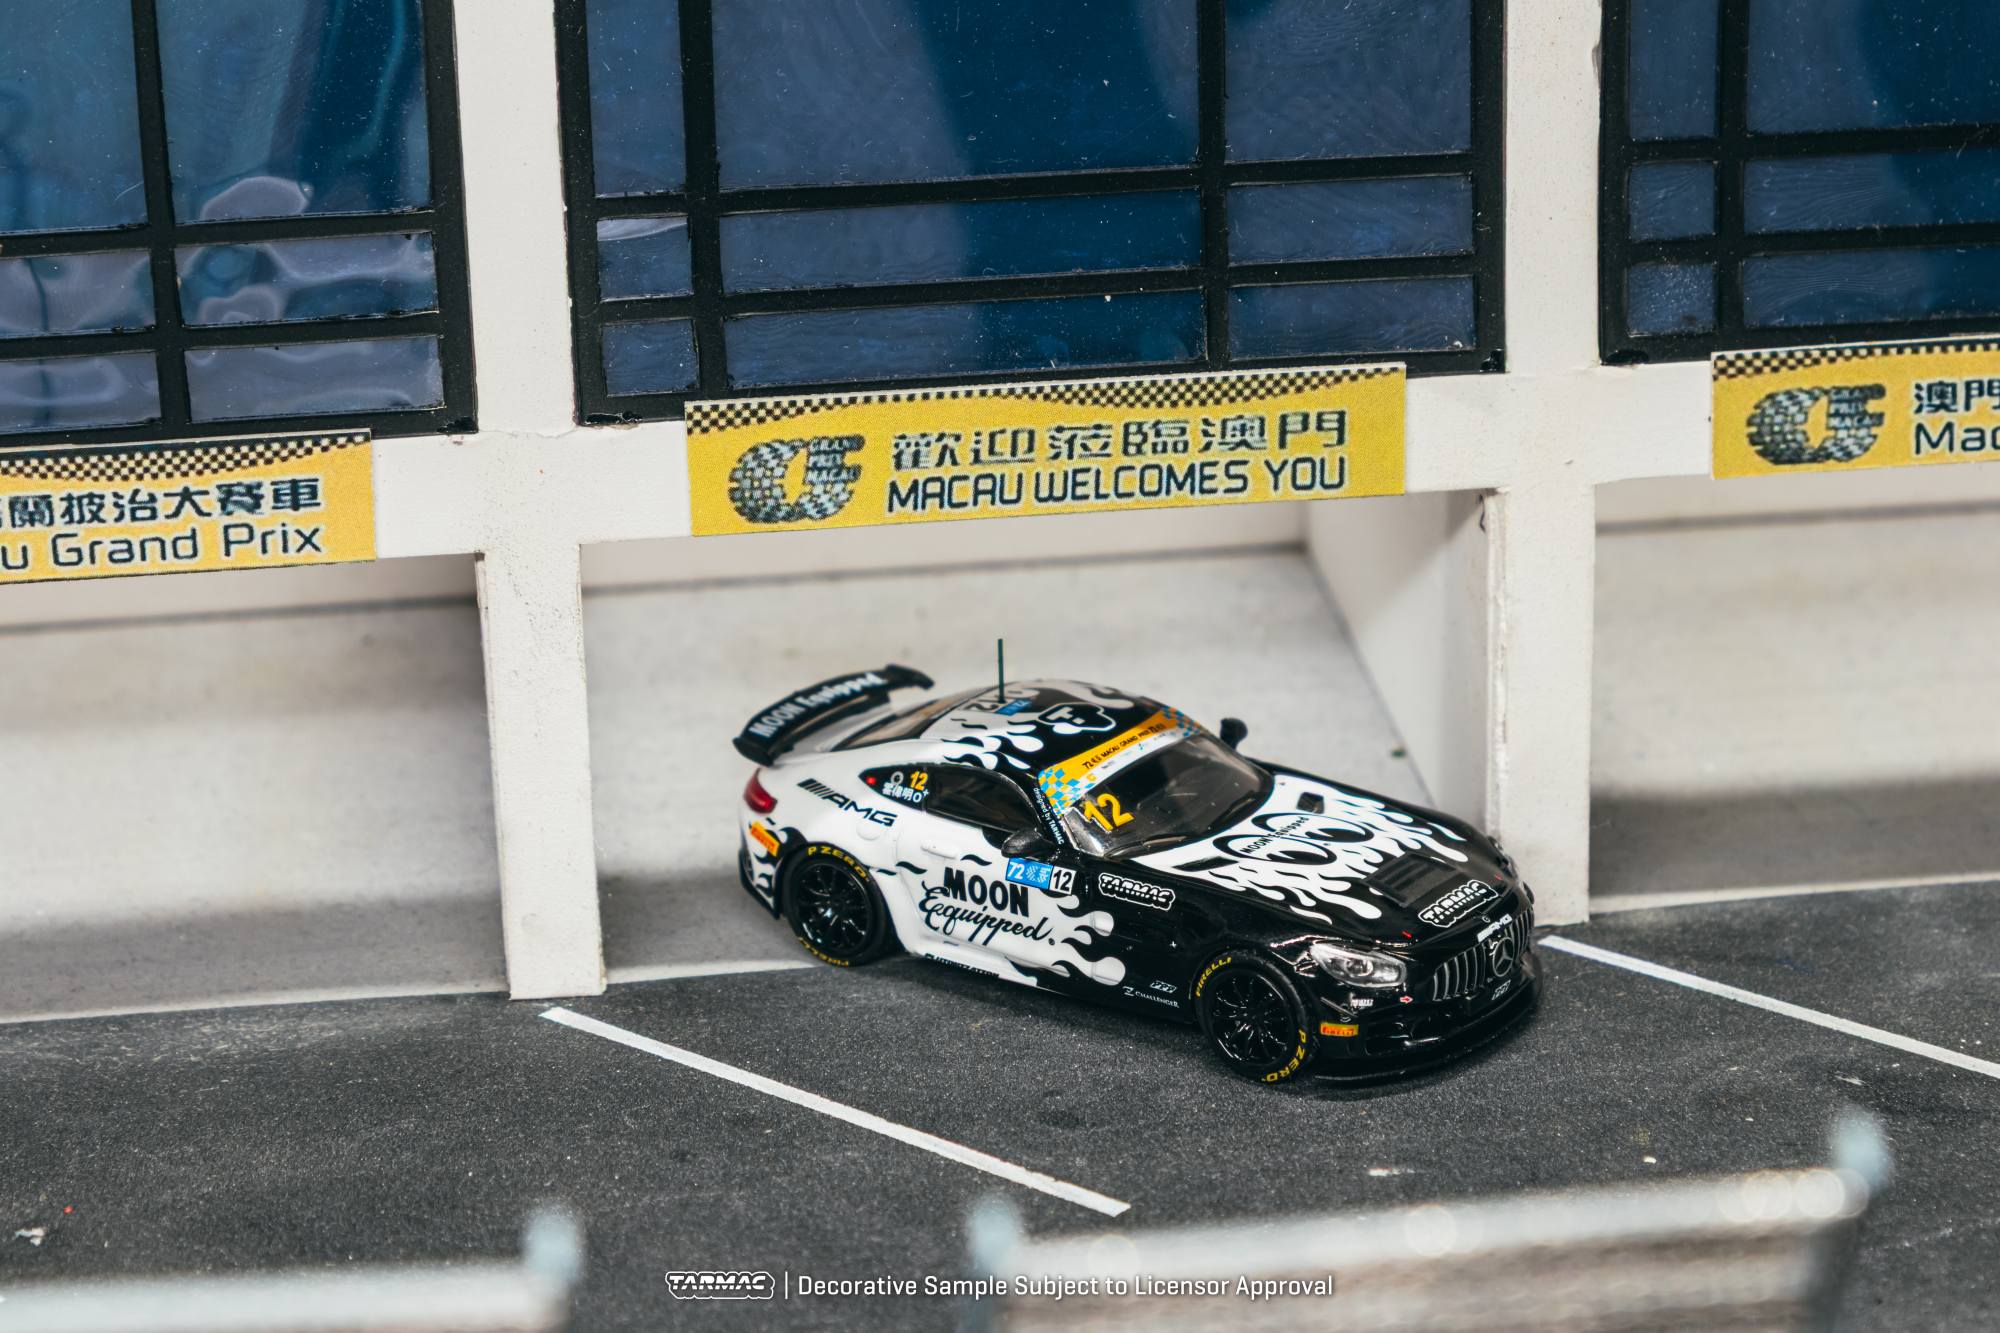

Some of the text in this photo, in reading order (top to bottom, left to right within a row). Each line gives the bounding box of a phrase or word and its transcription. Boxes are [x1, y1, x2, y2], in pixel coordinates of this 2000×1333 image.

[0, 478, 322, 528] 蘭披治大賽車
[888, 456, 1345, 513] MACAU WELCOMES YOU
[51, 526, 199, 567] Grand
[223, 522, 322, 557] Prix
[749, 701, 806, 738] MOON
[910, 771, 929, 791] 12
[1083, 793, 1135, 831] 12
[1048, 819, 1065, 845] TARMAC
[943, 866, 1029, 918] MOON
[1006, 861, 1026, 880] 72
[1053, 868, 1073, 892] 12
[1100, 873, 1172, 904] TARMAC
[1421, 881, 1489, 925] TARMAC
[1195, 956, 1232, 998] PIRELLI
[1266, 1045, 1306, 1083] ZERO
